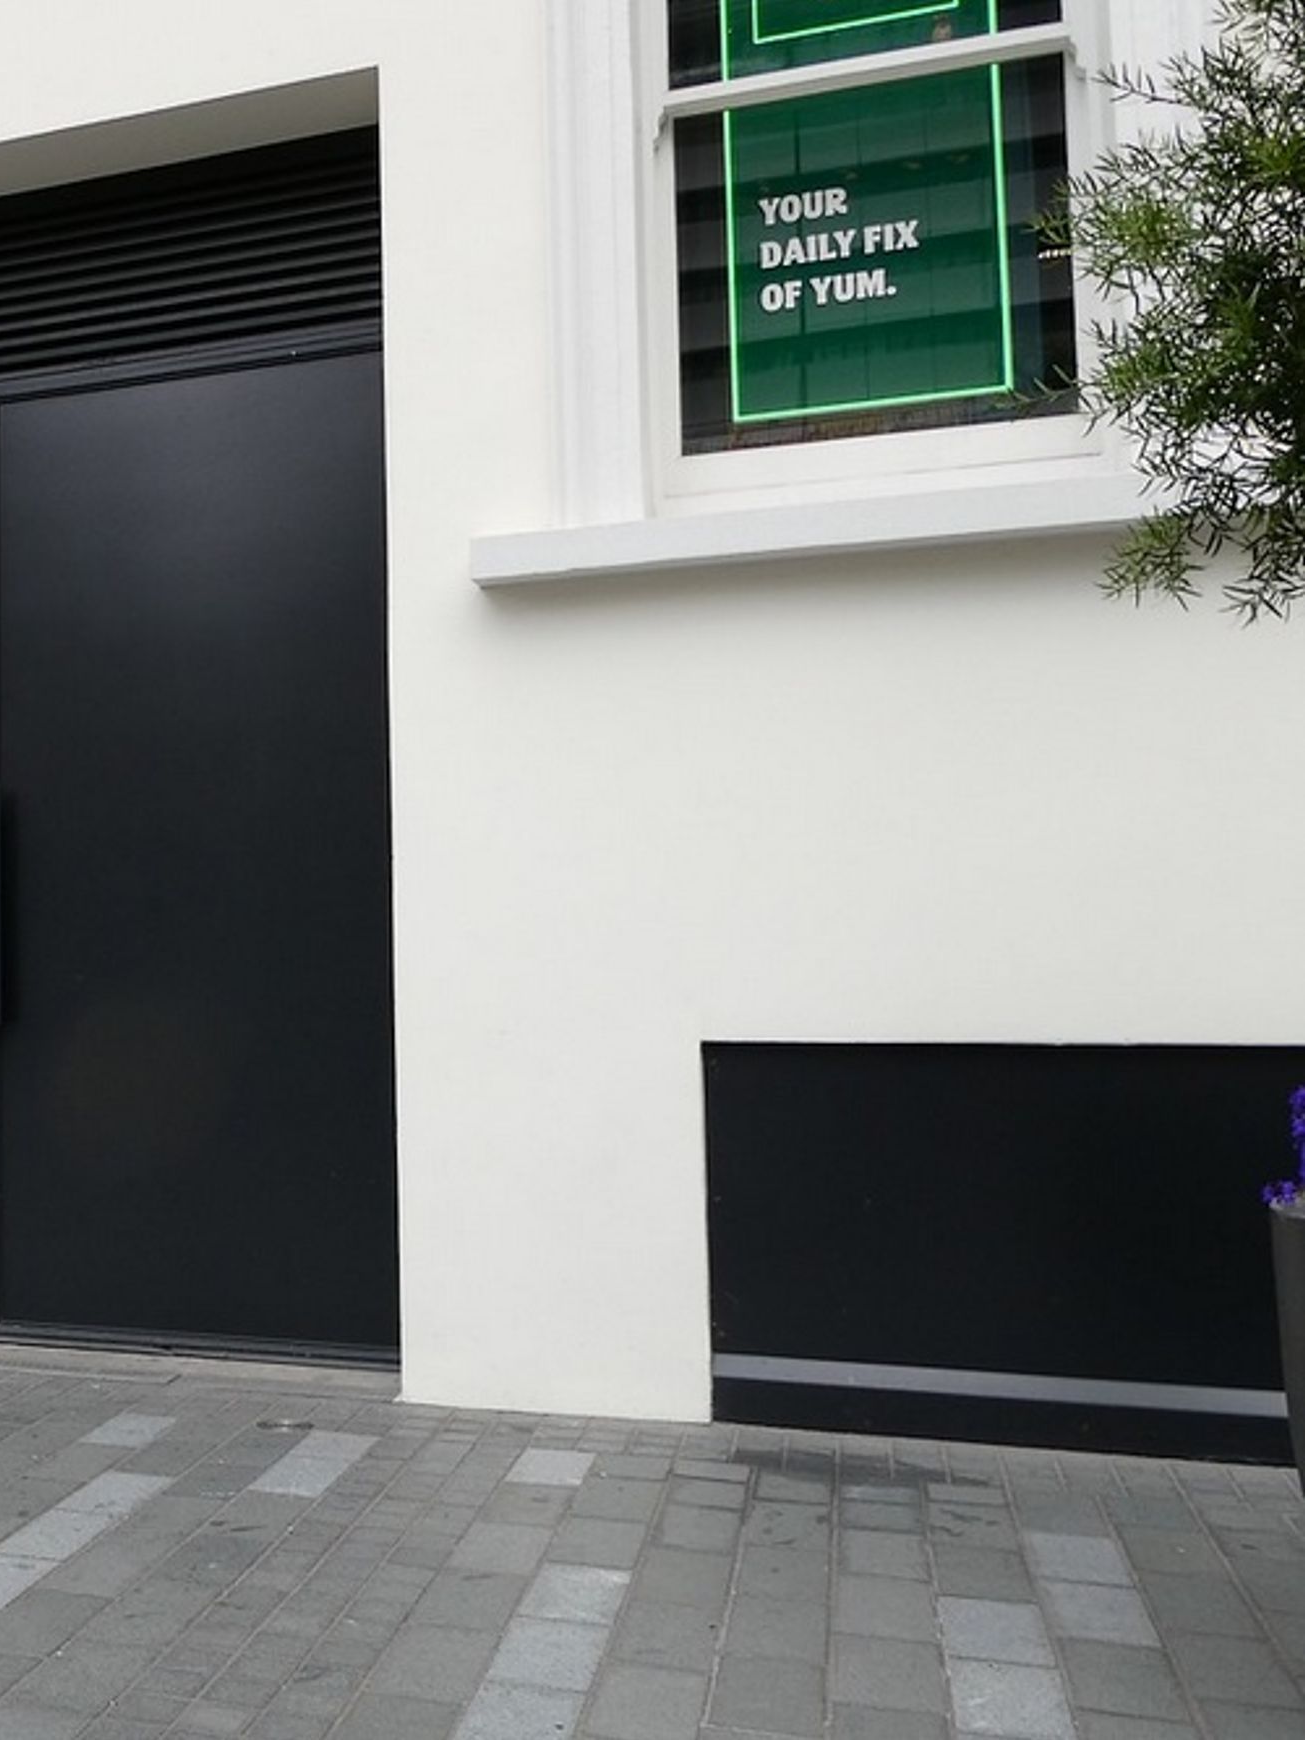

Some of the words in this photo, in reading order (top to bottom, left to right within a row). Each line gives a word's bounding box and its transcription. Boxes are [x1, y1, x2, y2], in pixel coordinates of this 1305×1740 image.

[758, 187, 848, 225] YOUR
[760, 229, 857, 269] DAILY
[863, 219, 920, 254] FIX
[760, 280, 803, 312] OF
[809, 268, 897, 305] YUM.
